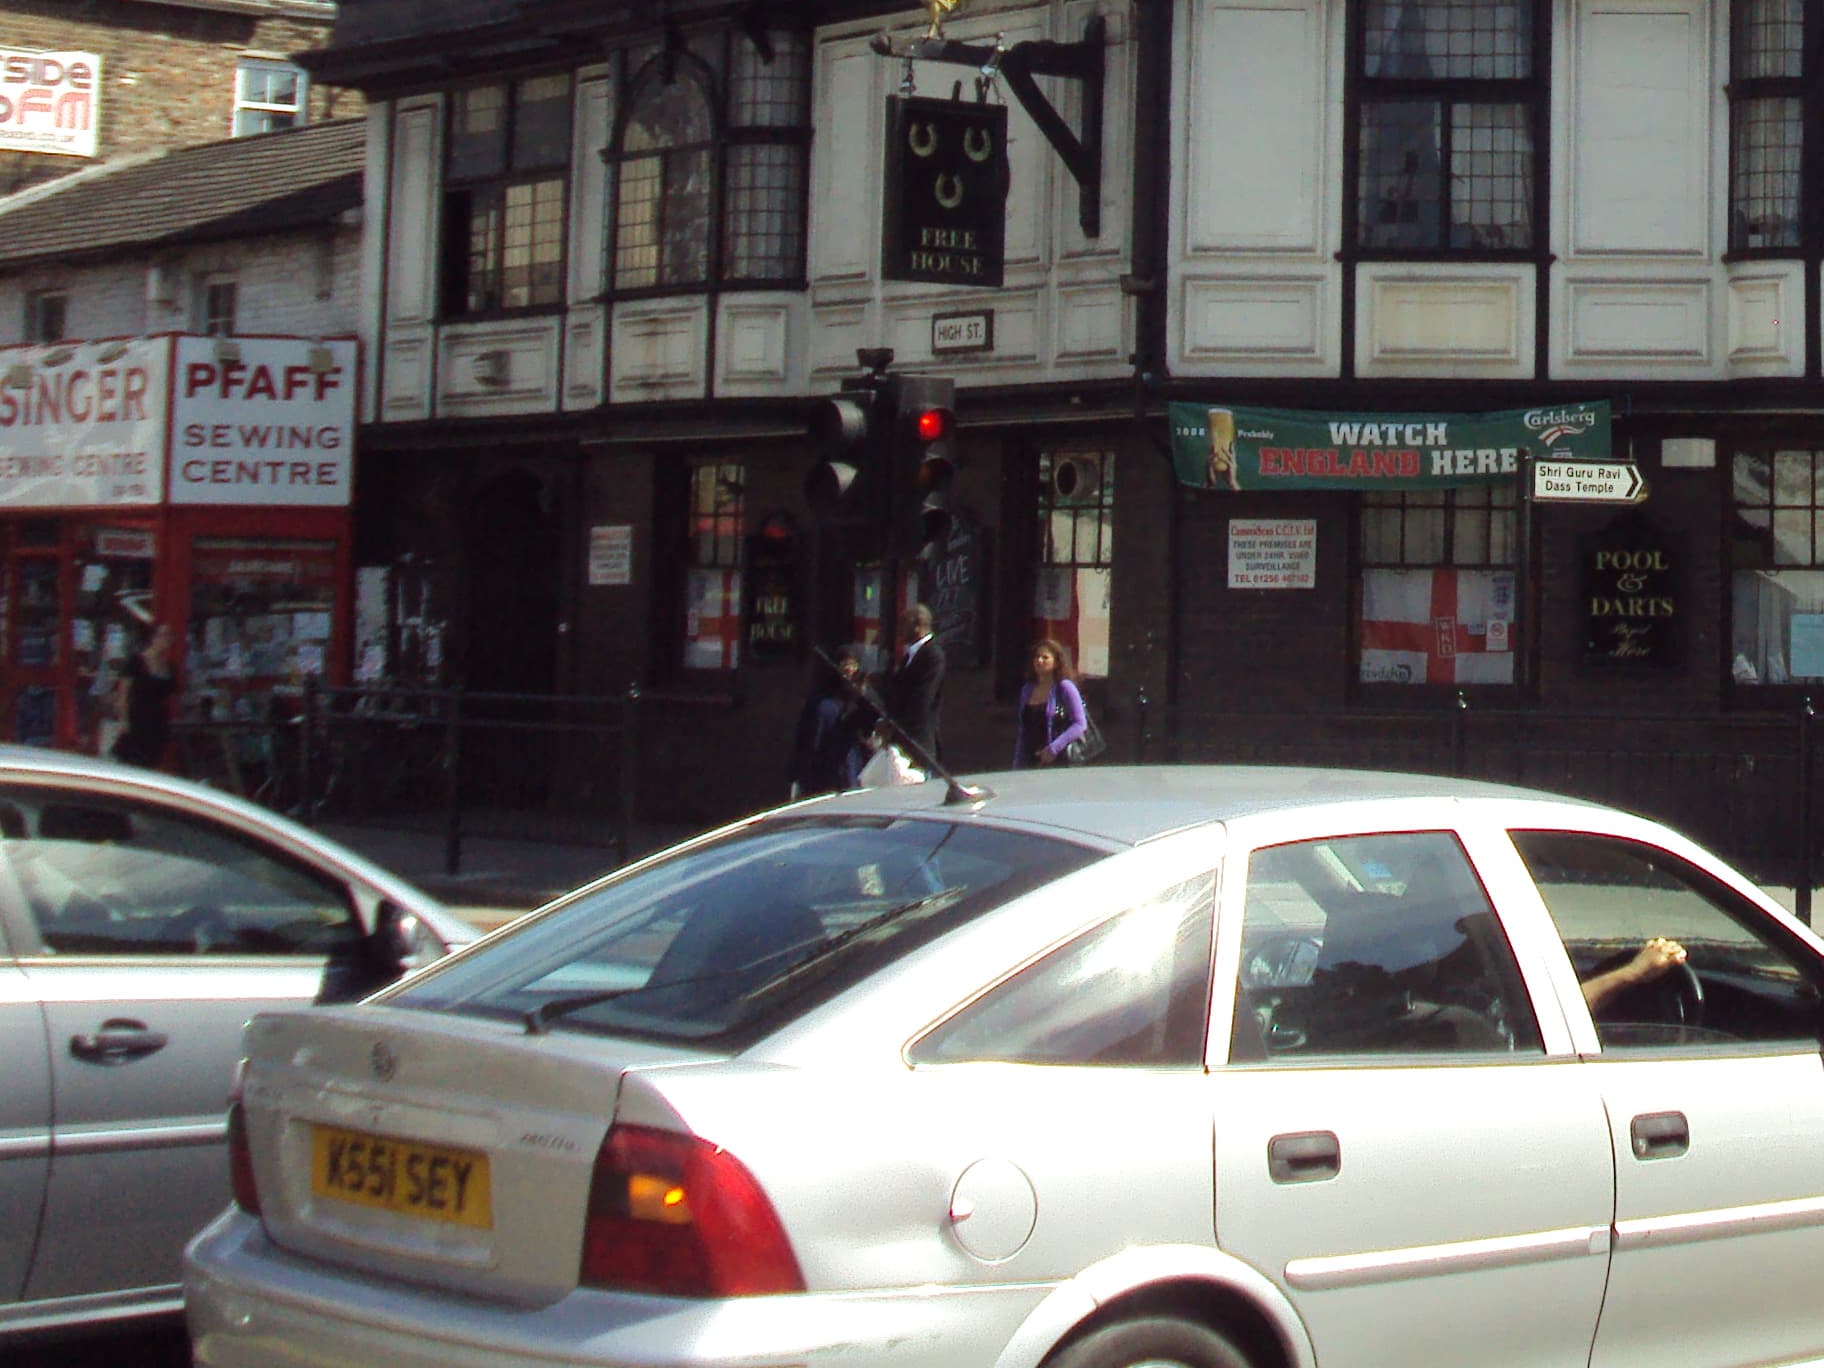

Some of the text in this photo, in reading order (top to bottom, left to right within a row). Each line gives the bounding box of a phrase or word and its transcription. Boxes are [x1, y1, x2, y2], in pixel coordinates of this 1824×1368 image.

[921, 227, 977, 250] FREE
[911, 251, 985, 274] HOUSE
[938, 322, 983, 341] HIGH ST.
[184, 362, 343, 402] PFAFF
[0, 367, 150, 427] SINGER
[1523, 405, 1596, 430] Carlsberg
[183, 424, 341, 450] SEWING
[1328, 422, 1448, 446] WATCH
[182, 460, 338, 486] CENTRE
[1258, 447, 1519, 477] ENGLAND HERE
[1538, 466, 1621, 480] Shri Guru Ravi
[1545, 480, 1614, 494] Dass Temple
[1595, 550, 1670, 571] POOL
[1616, 573, 1649, 593] &
[1590, 596, 1675, 617] DARTS
[406, 1151, 474, 1214] SEY
